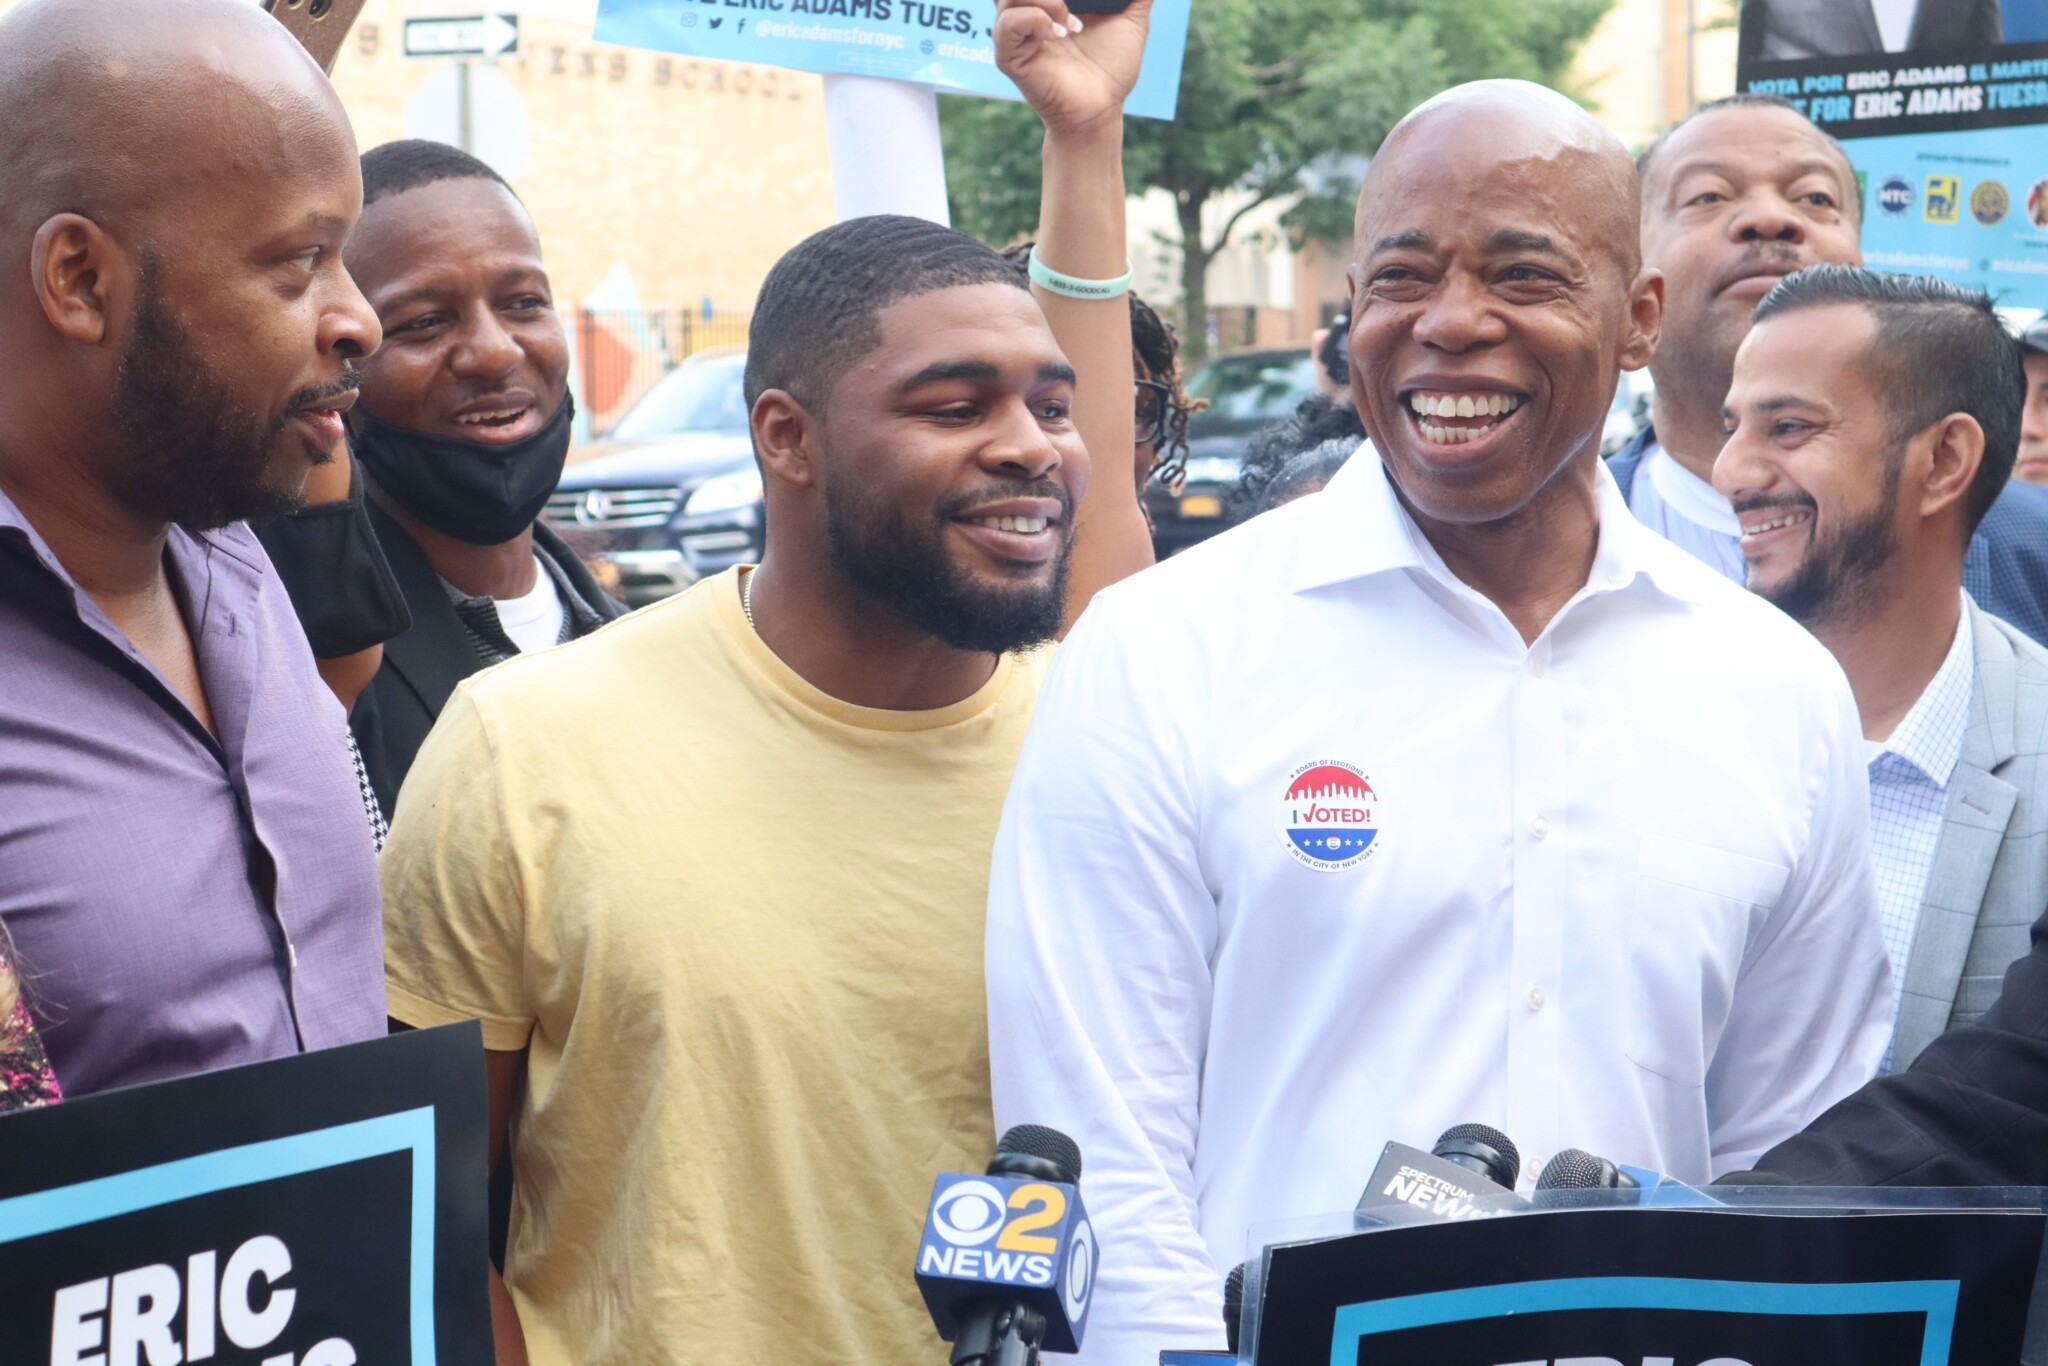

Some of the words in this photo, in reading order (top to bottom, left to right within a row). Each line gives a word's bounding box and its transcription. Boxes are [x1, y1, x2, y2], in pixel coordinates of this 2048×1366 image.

[755, 19, 904, 51] @ericadamsfornyc
[790, 0, 891, 20] ADAMS
[900, 1, 977, 39] TUES,
[1748, 78, 1800, 95] VOTA
[1802, 73, 1844, 94] POR
[1846, 69, 1891, 91] ERIC
[1893, 63, 1967, 87] ADAMS
[1810, 95, 1852, 123] FOR
[1854, 90, 1904, 119] ERIC
[1906, 84, 1984, 115] ADAMS
[1295, 761, 1318, 775] BOARD
[1330, 760, 1364, 777] ELECTIONS
[1292, 809, 1298, 824] I
[1291, 848, 1299, 858] IN
[1300, 854, 1312, 865] THE
[1313, 860, 1329, 869] CITY
[1342, 858, 1357, 869] NEW
[1357, 848, 1375, 862] YORK
[1398, 1166, 1476, 1203] SPECTRUM
[995, 1183, 1066, 1255] 2
[920, 1245, 1053, 1285] NEWS
[50, 1235, 297, 1366] ERIC
